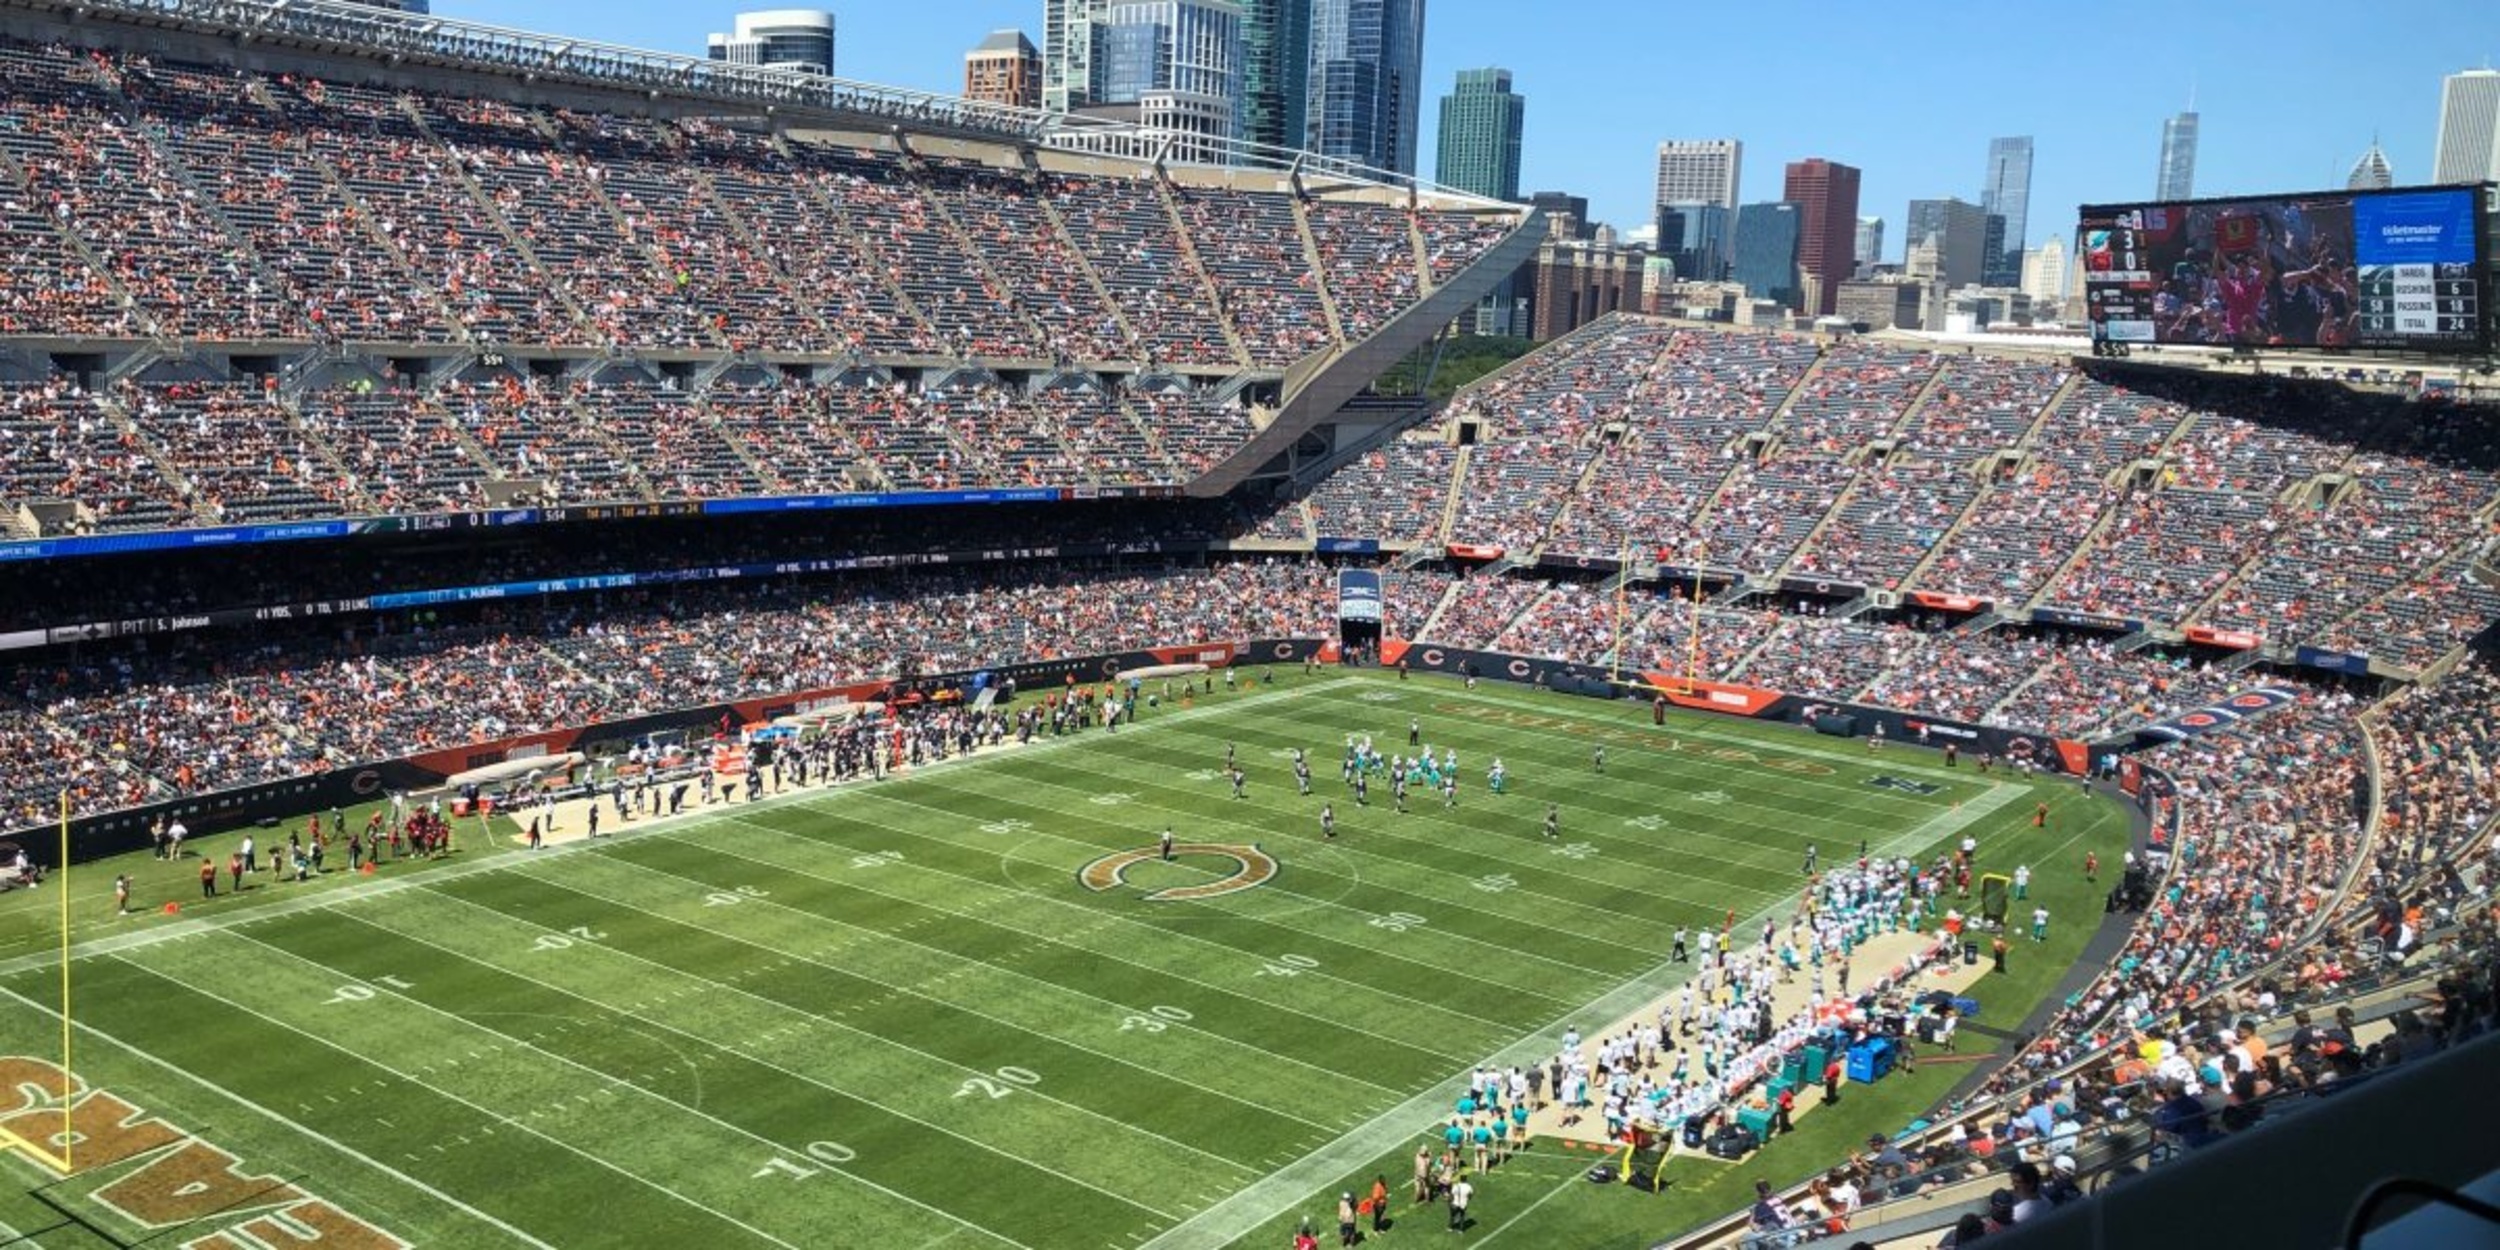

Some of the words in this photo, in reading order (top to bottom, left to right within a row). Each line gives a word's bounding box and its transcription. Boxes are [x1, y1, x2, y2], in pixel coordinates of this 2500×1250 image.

[2124, 231, 2133, 249] 3
[2126, 252, 2136, 270] 0
[2372, 284, 2380, 294] 4
[2451, 283, 2459, 294] 6
[2450, 318, 2465, 330] 24
[399, 518, 407, 531] 3
[470, 513, 478, 526] 0
[122, 620, 144, 635] PIT
[1263, 953, 1320, 977] 40
[1120, 1005, 1194, 1032] 30
[962, 1066, 1041, 1099] 20
[766, 1141, 856, 1181] 10
